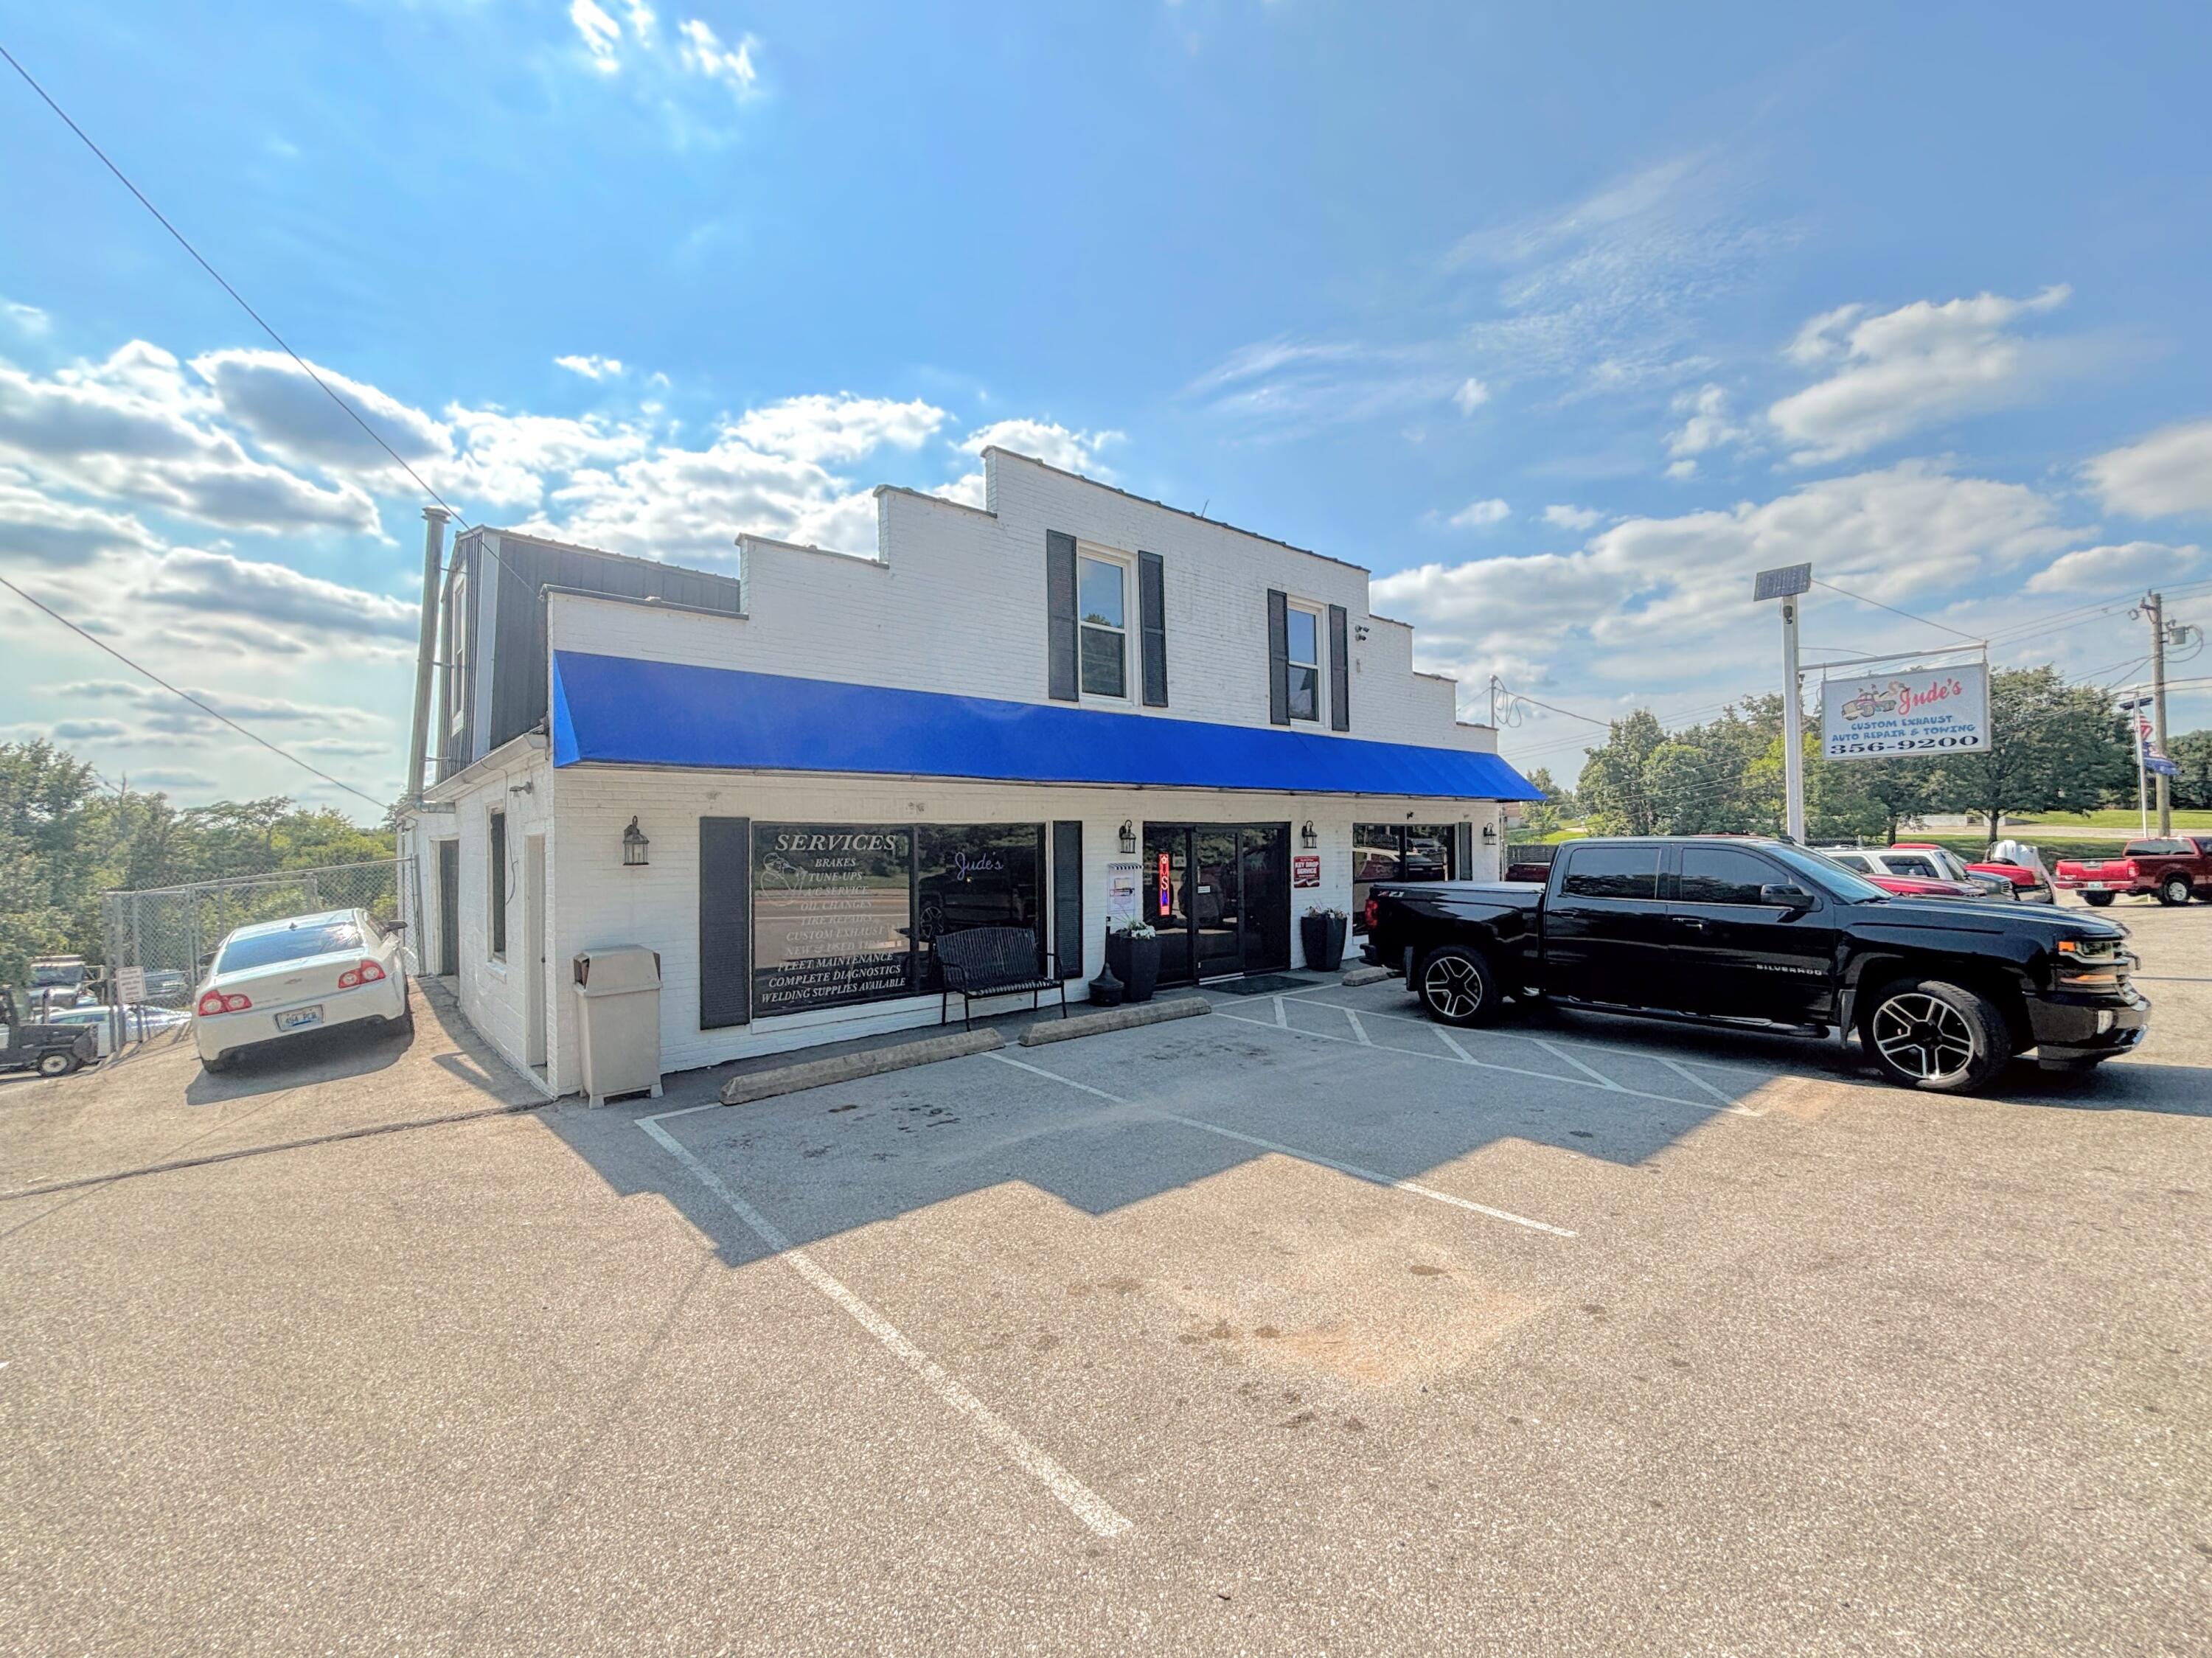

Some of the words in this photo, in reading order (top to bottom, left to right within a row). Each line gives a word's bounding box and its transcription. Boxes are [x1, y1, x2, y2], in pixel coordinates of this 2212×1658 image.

[1898, 678, 1963, 715] Jude's
[1851, 720, 1897, 730] CUSTOM
[1902, 715, 1952, 726] EXHAUST
[1832, 733, 1859, 742] AUTO
[1863, 728, 1905, 739] REPAIR
[1910, 728, 1919, 736] &
[1924, 724, 1975, 735] TOWING
[1830, 735, 1979, 755] 356-9200
[775, 835, 897, 851] SERVICES
[815, 858, 856, 868] BRAKES
[955, 851, 1004, 880] Jude's
[809, 871, 863, 882] TUNE-UPS
[825, 886, 869, 896] SERVICE
[801, 902, 820, 911] OIL
[822, 900, 872, 910] CHANGES
[801, 916, 827, 926] TIRE
[828, 914, 873, 924] REPAIRS
[786, 930, 832, 941] CUSTOM
[836, 927, 883, 938] EXHAUST
[786, 946, 812, 956] NEW
[827, 942, 855, 952] USED
[778, 959, 814, 972] FLEET
[816, 952, 894, 968] MAINTENANCE
[768, 972, 830, 988] COMPLETE
[833, 964, 901, 980] DIAGNOSTICS
[762, 988, 811, 1003] WELDING
[812, 982, 858, 997] SUPPLIES
[858, 978, 906, 992] AVAILABLE
